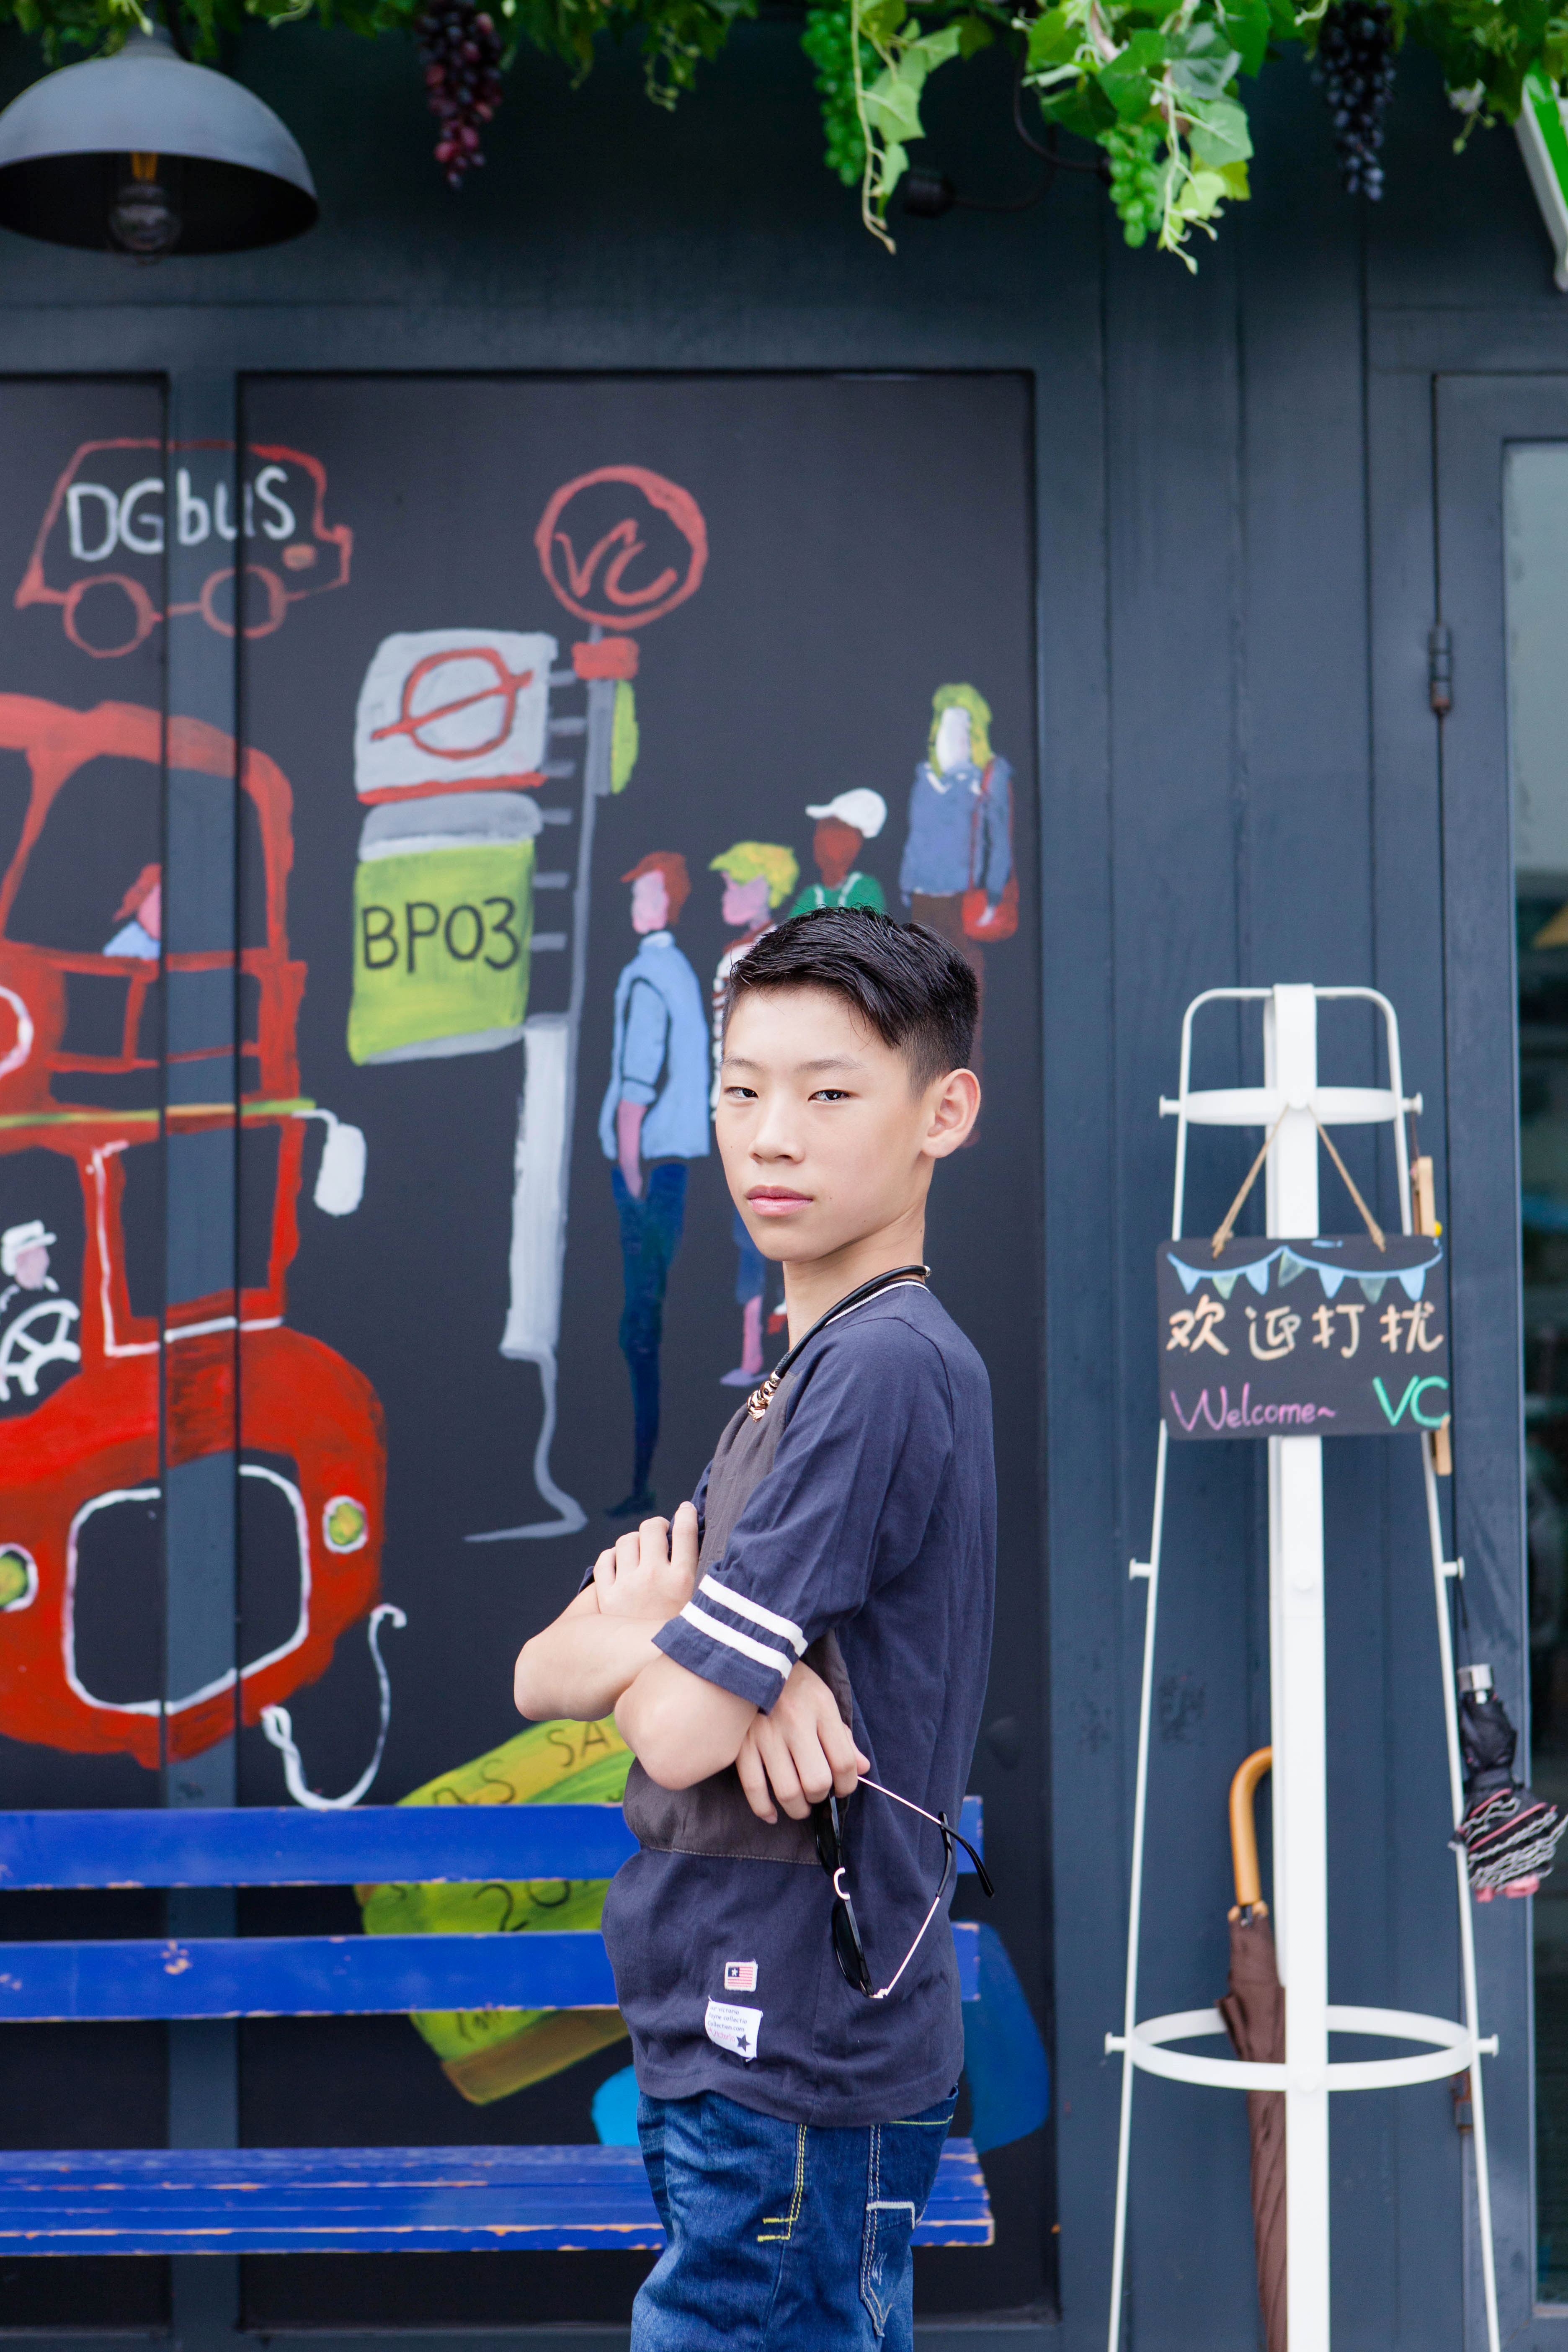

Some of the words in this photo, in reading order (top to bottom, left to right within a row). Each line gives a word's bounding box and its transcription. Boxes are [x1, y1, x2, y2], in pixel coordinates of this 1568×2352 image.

[1166, 1294, 1444, 1361] 欢迎打扰
[1372, 1375, 1449, 1427] VC
